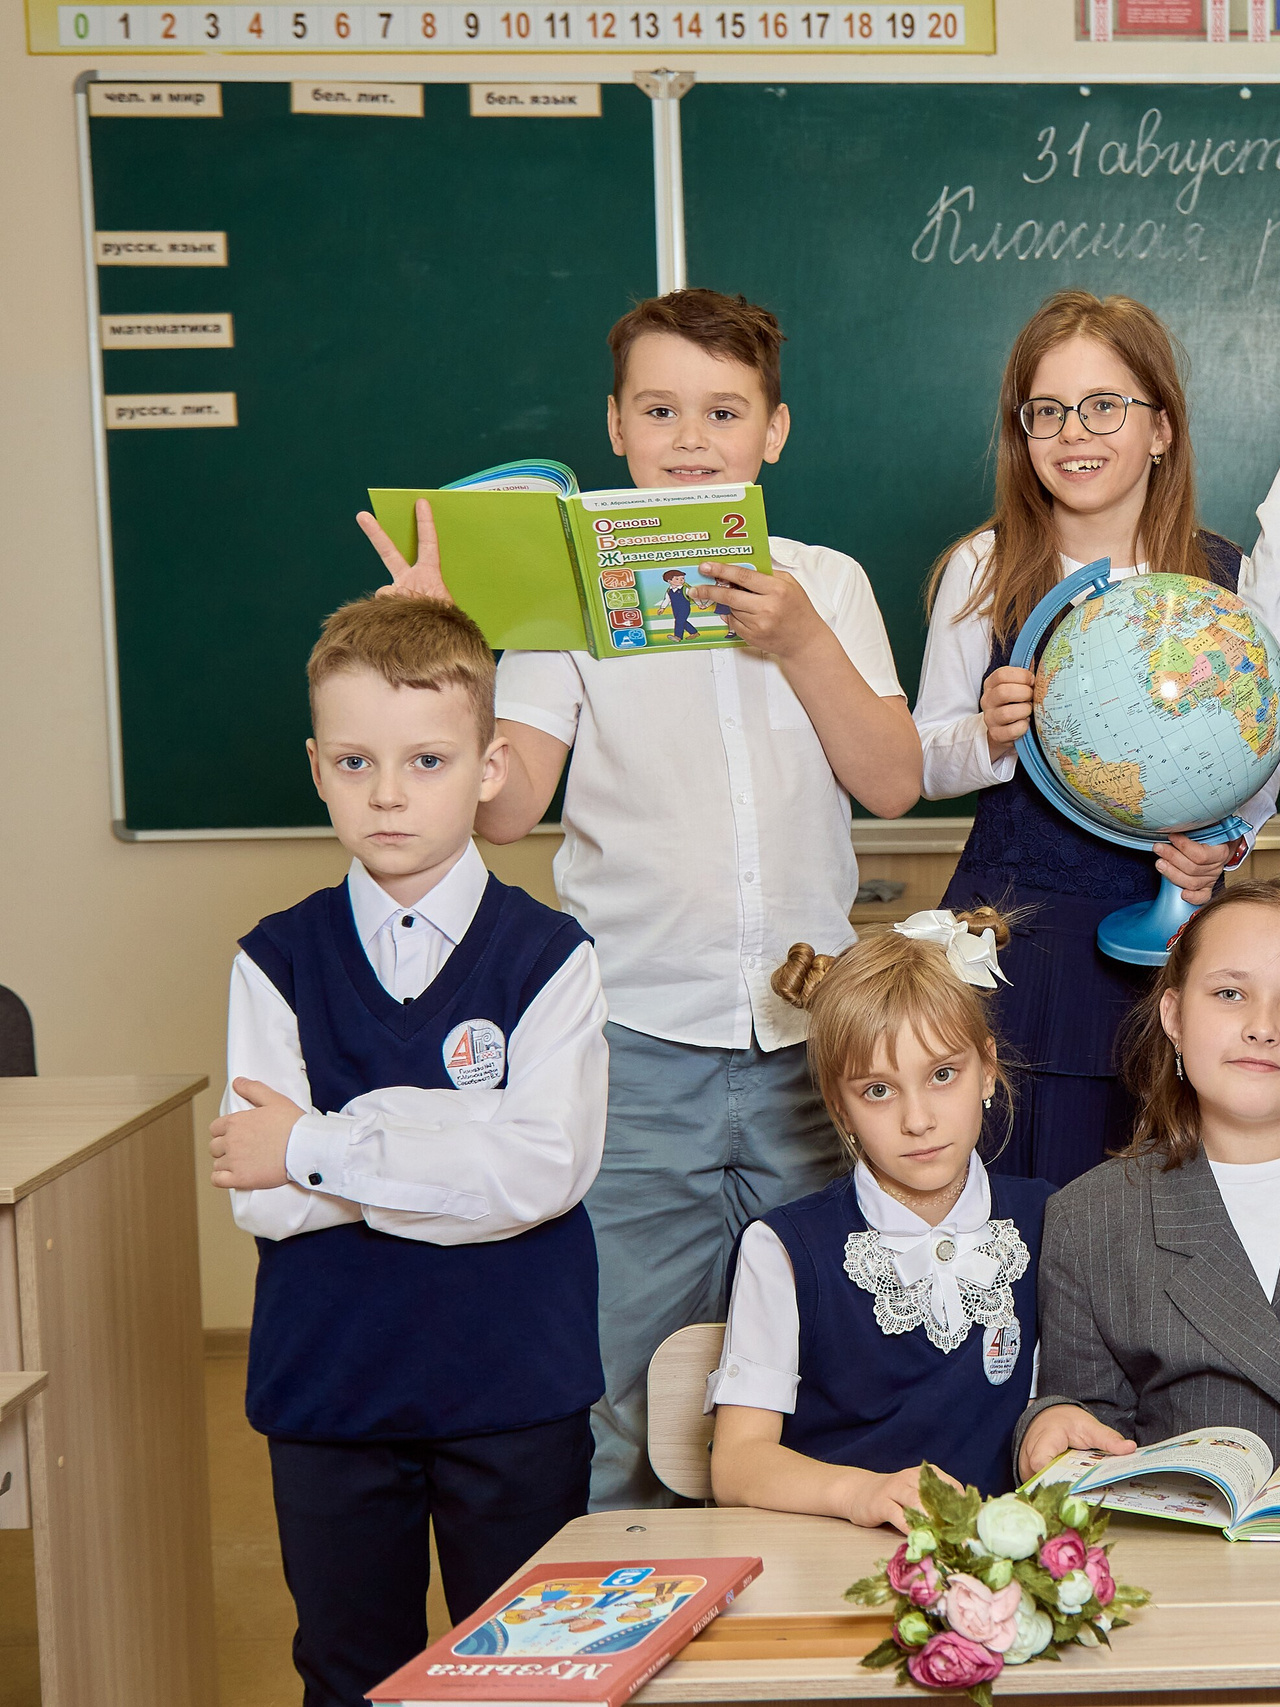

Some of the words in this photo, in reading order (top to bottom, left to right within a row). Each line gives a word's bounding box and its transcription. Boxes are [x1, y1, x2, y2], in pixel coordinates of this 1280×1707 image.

[72, 12, 91, 40] 0
[117, 12, 133, 40] 1
[160, 12, 178, 40] 2
[203, 12, 222, 40] 3
[246, 12, 265, 40] 4
[291, 12, 309, 40] 5
[334, 12, 352, 40] 6
[376, 12, 395, 40] 7
[421, 12, 438, 40] 8
[463, 12, 481, 40] 9
[500, 12, 531, 40] 10
[544, 12, 572, 40] 11
[586, 12, 617, 40] 12
[629, 12, 661, 40] 13
[672, 12, 704, 40] 14
[715, 12, 747, 40] 15
[758, 12, 789, 40] 16
[800, 12, 831, 40] 17
[843, 12, 874, 40] 18
[886, 12, 916, 40] 19
[927, 12, 958, 40] 20
[104, 93, 145, 103] чел.
[151, 93, 162, 102] и
[168, 93, 204, 105] мир
[311, 88, 351, 102] бел.
[357, 92, 395, 104] лит.
[486, 92, 524, 105] бел.
[530, 95, 577, 106] язык
[1023, 122, 1090, 183] 31
[911, 185, 1209, 265] Классная
[102, 242, 163, 256] русск.
[169, 242, 216, 253] язык
[109, 323, 222, 335] математика
[116, 404, 176, 419] русск.
[183, 403, 220, 416] лит.
[594, 518, 660, 533] Основы
[721, 513, 748, 540] 2
[598, 531, 709, 549] Безопасности
[599, 545, 751, 565] Жизнедеятельности
[612, 1572, 642, 1585] 2
[725, 1588, 735, 1605] 2
[426, 1660, 614, 1681] Музыка
